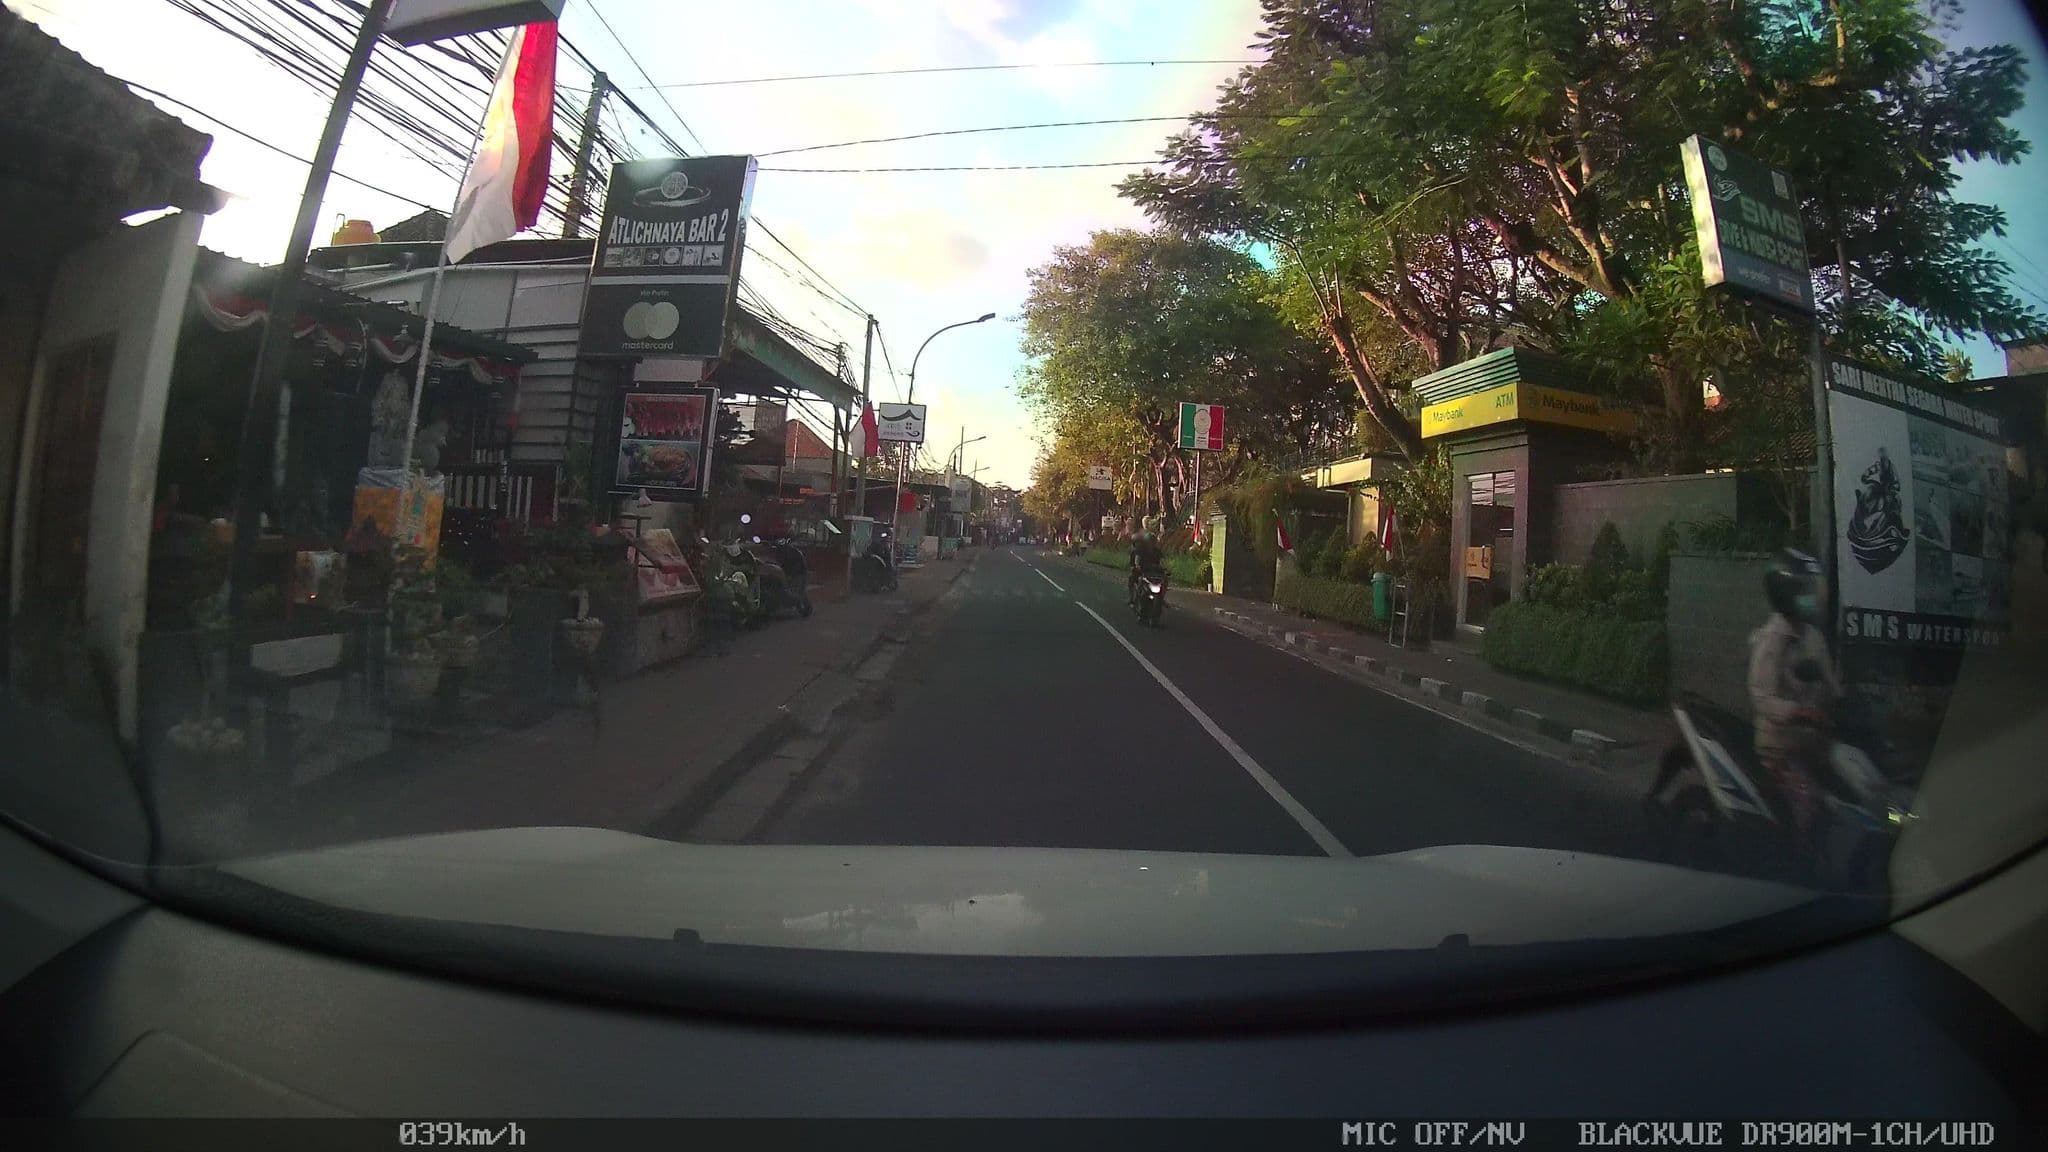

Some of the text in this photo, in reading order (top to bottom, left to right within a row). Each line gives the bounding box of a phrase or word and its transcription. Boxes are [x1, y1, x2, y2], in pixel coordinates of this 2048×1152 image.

[607, 208, 729, 245] ATLICHNAYA BAR 2
[1740, 195, 1802, 245] SMS
[622, 340, 674, 350] mastercard
[1831, 361, 1862, 391] SARI
[1432, 391, 1514, 423] Maybank ATM
[1542, 395, 1600, 415] Maybank
